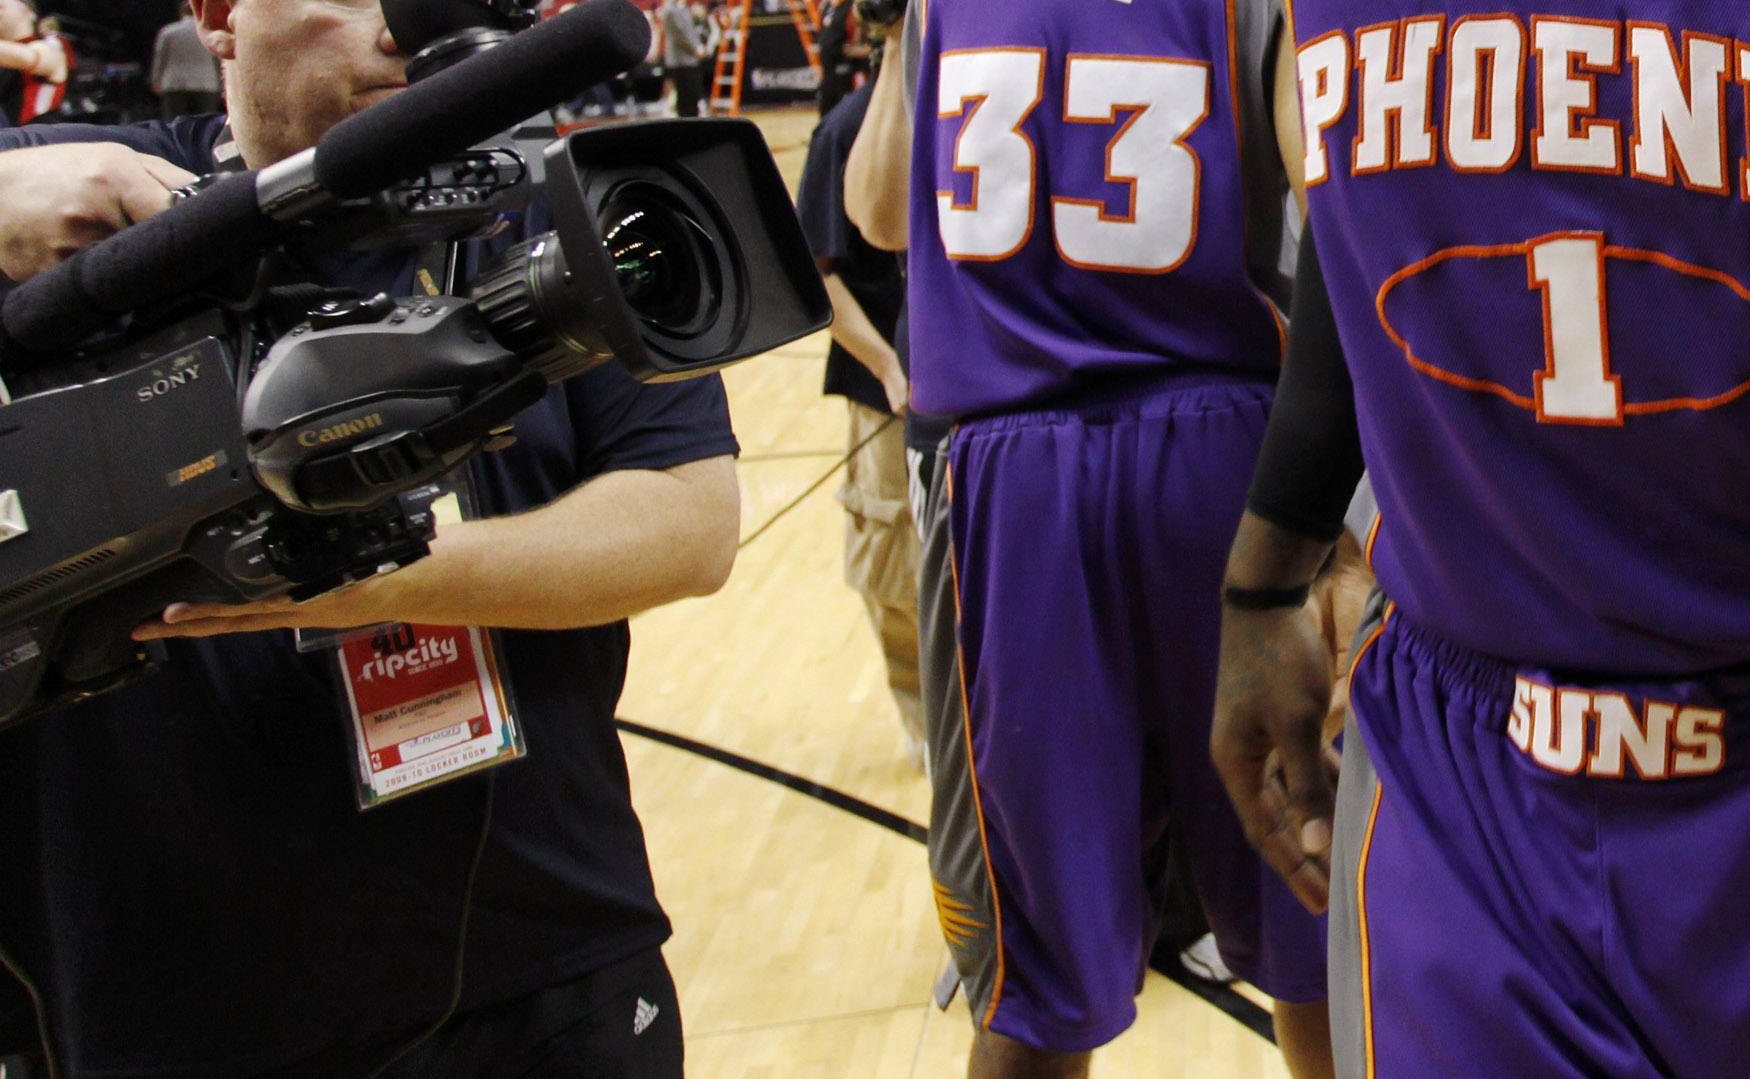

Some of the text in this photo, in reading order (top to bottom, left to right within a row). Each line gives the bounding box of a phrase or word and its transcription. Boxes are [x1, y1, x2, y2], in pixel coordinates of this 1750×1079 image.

[936, 46, 1211, 275] 33
[1526, 230, 1625, 427] 1
[137, 363, 201, 403] SONY
[298, 413, 384, 447] Canon
[1507, 674, 1727, 781] SUNS
